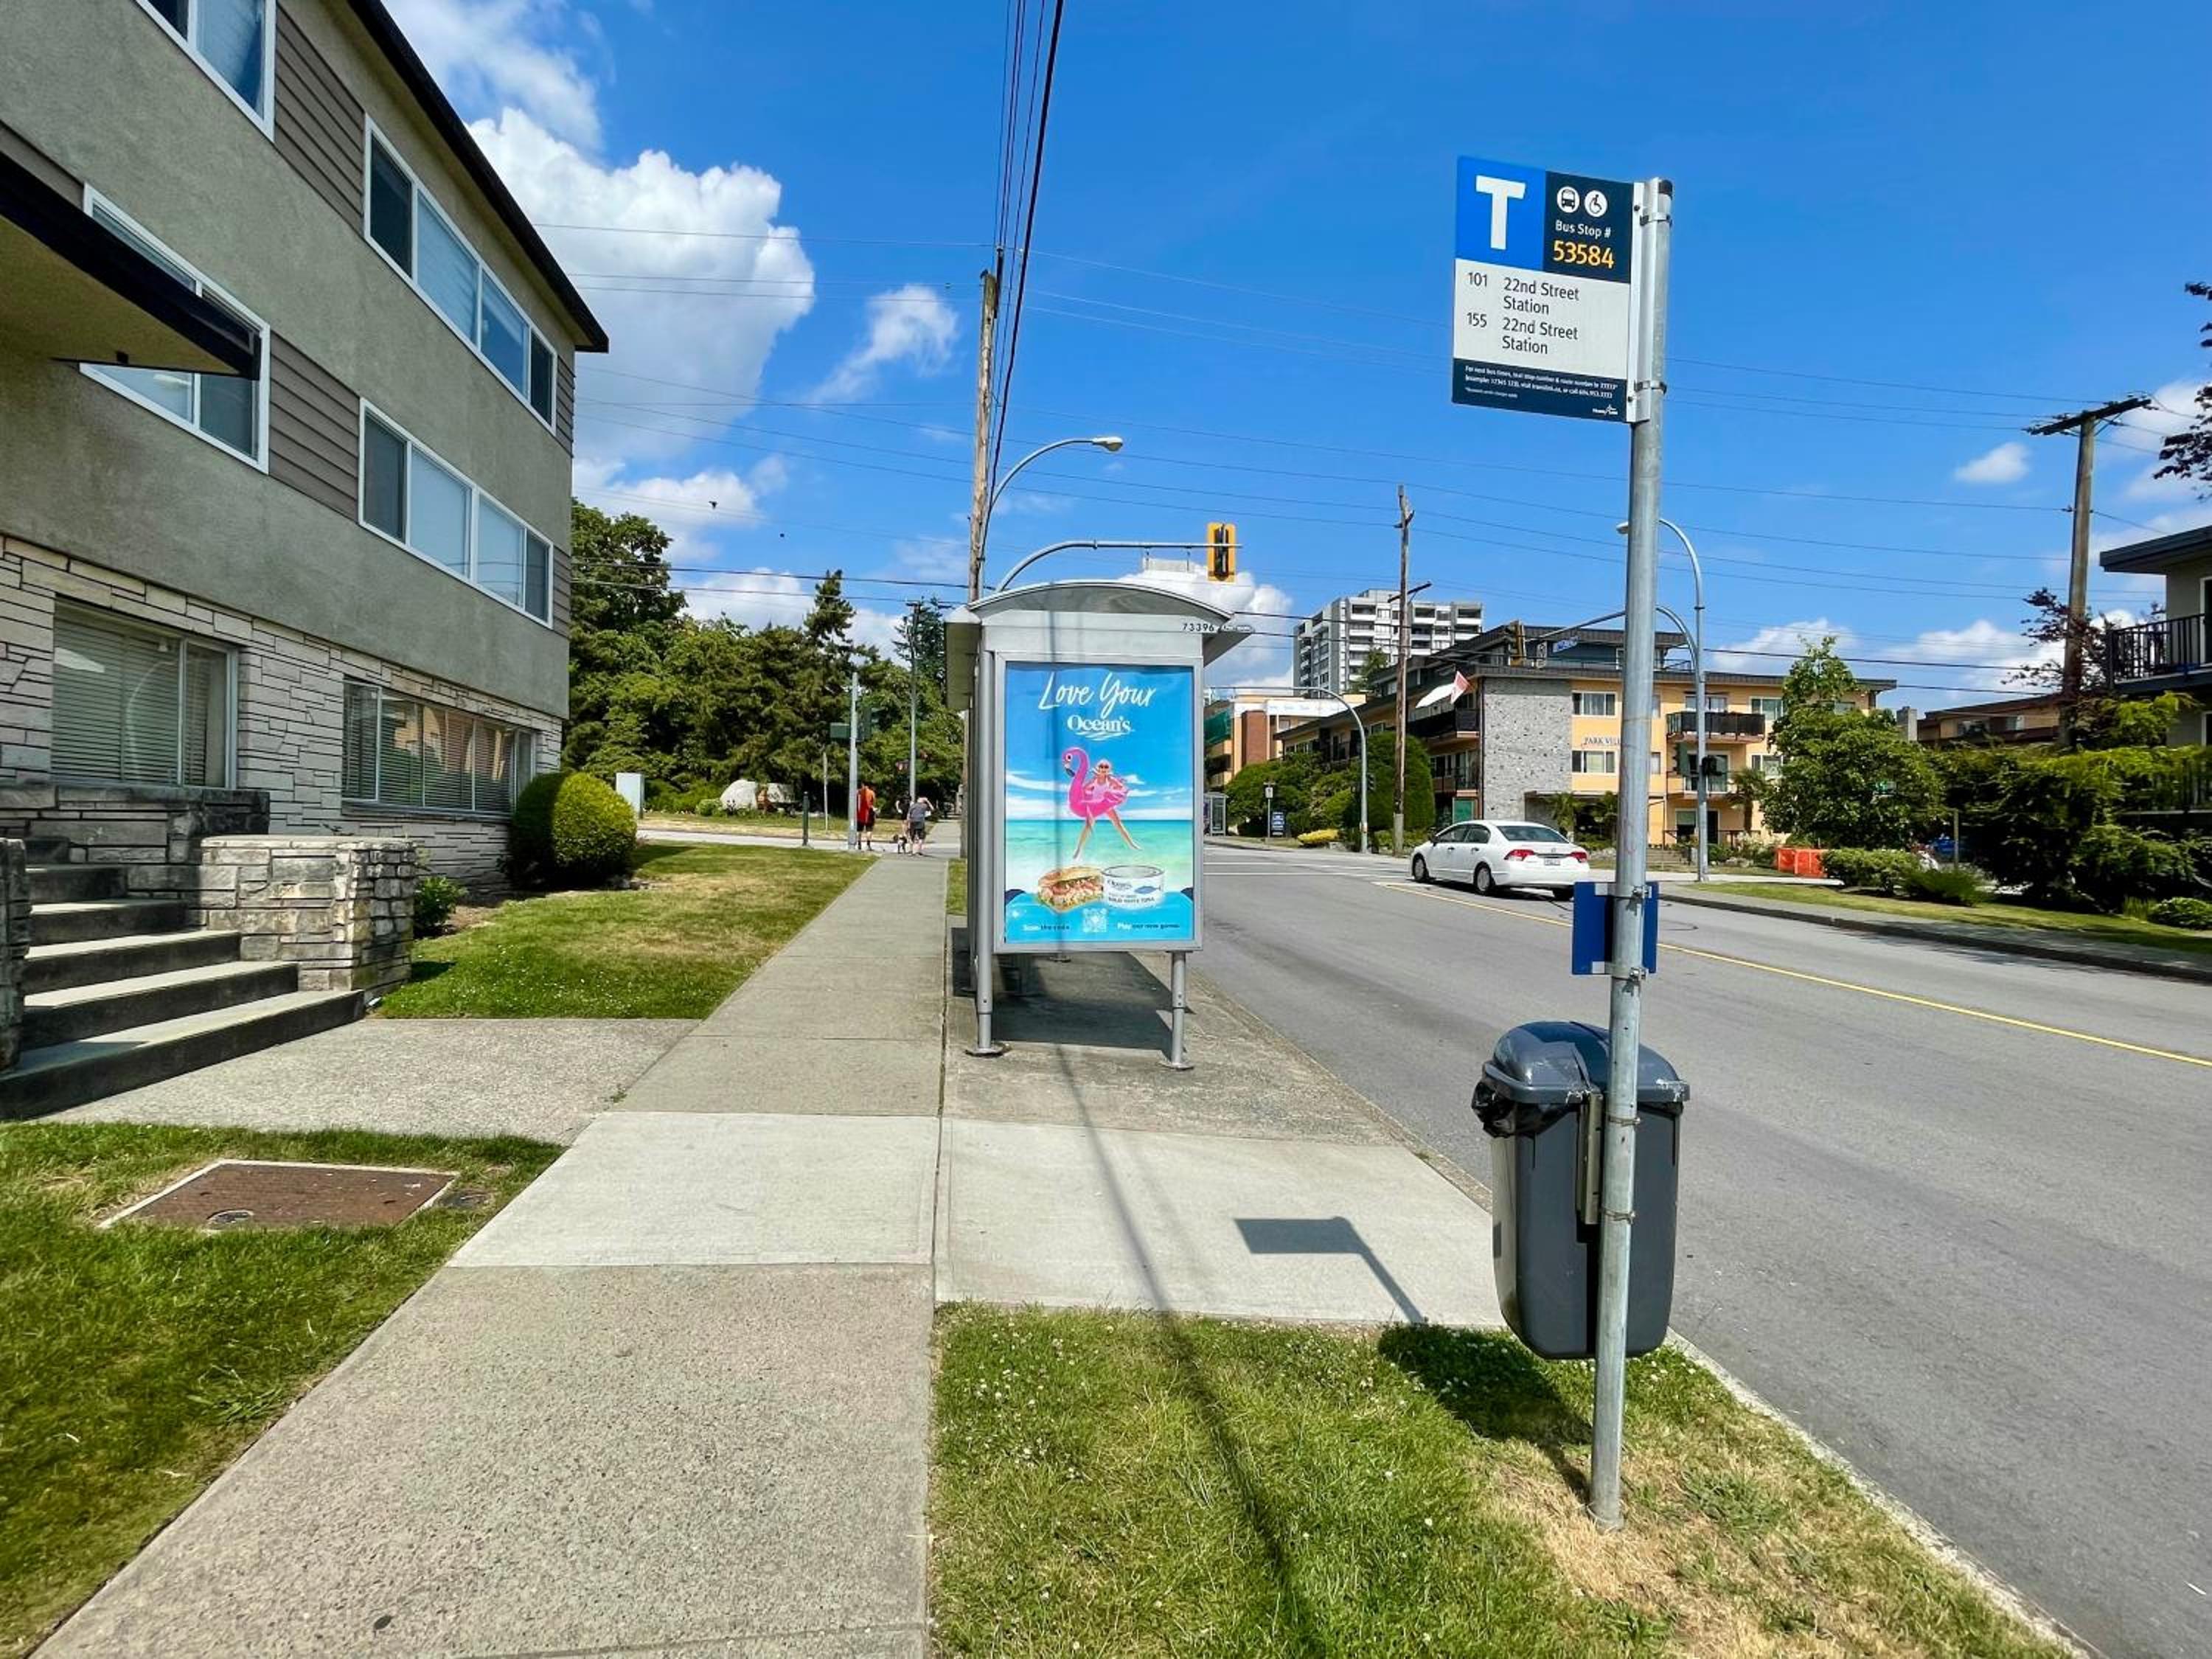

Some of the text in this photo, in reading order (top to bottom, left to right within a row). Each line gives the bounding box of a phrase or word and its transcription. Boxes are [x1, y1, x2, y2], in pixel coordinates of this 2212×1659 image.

[1475, 175, 1526, 251] T
[1555, 220, 1612, 240] Bus Stop #
[1553, 240, 1615, 269] 53584
[1468, 272, 1580, 302] 101 22nd Street
[1503, 296, 1550, 315] Station
[1467, 313, 1579, 341] 155 22nd Street
[1502, 336, 1548, 355] Station
[1183, 623, 1215, 632] 73396
[1038, 672, 1157, 720] Love Your
[1067, 714, 1131, 732] Ocean's
